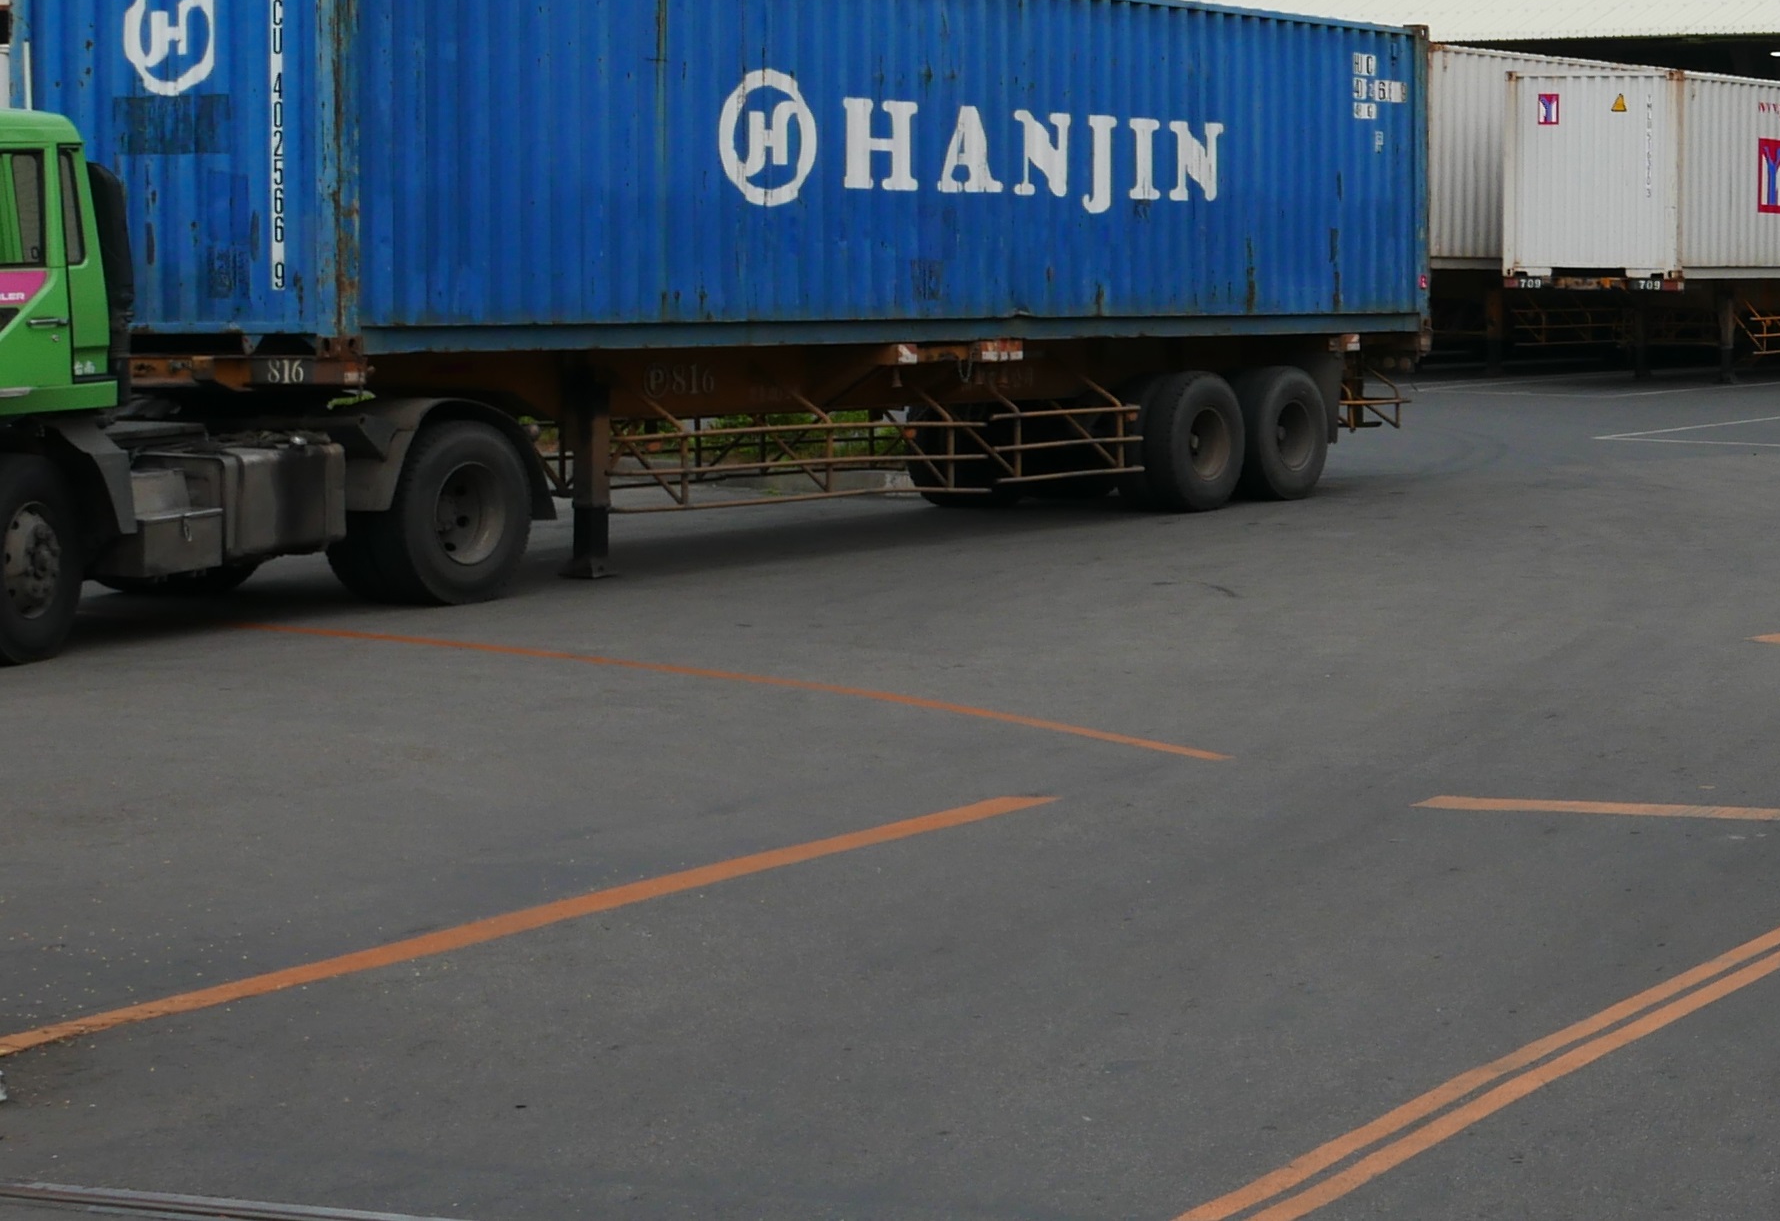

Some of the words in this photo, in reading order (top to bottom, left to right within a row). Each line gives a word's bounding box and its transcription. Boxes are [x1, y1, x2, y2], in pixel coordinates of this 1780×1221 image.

[272, 72, 284, 243] 402566
[842, 97, 1225, 214] HANJIN
[274, 261, 285, 289] 9
[1520, 280, 1542, 289] 709
[1639, 280, 1661, 290] 709
[0, 292, 25, 300] LER
[267, 359, 304, 384] 816
